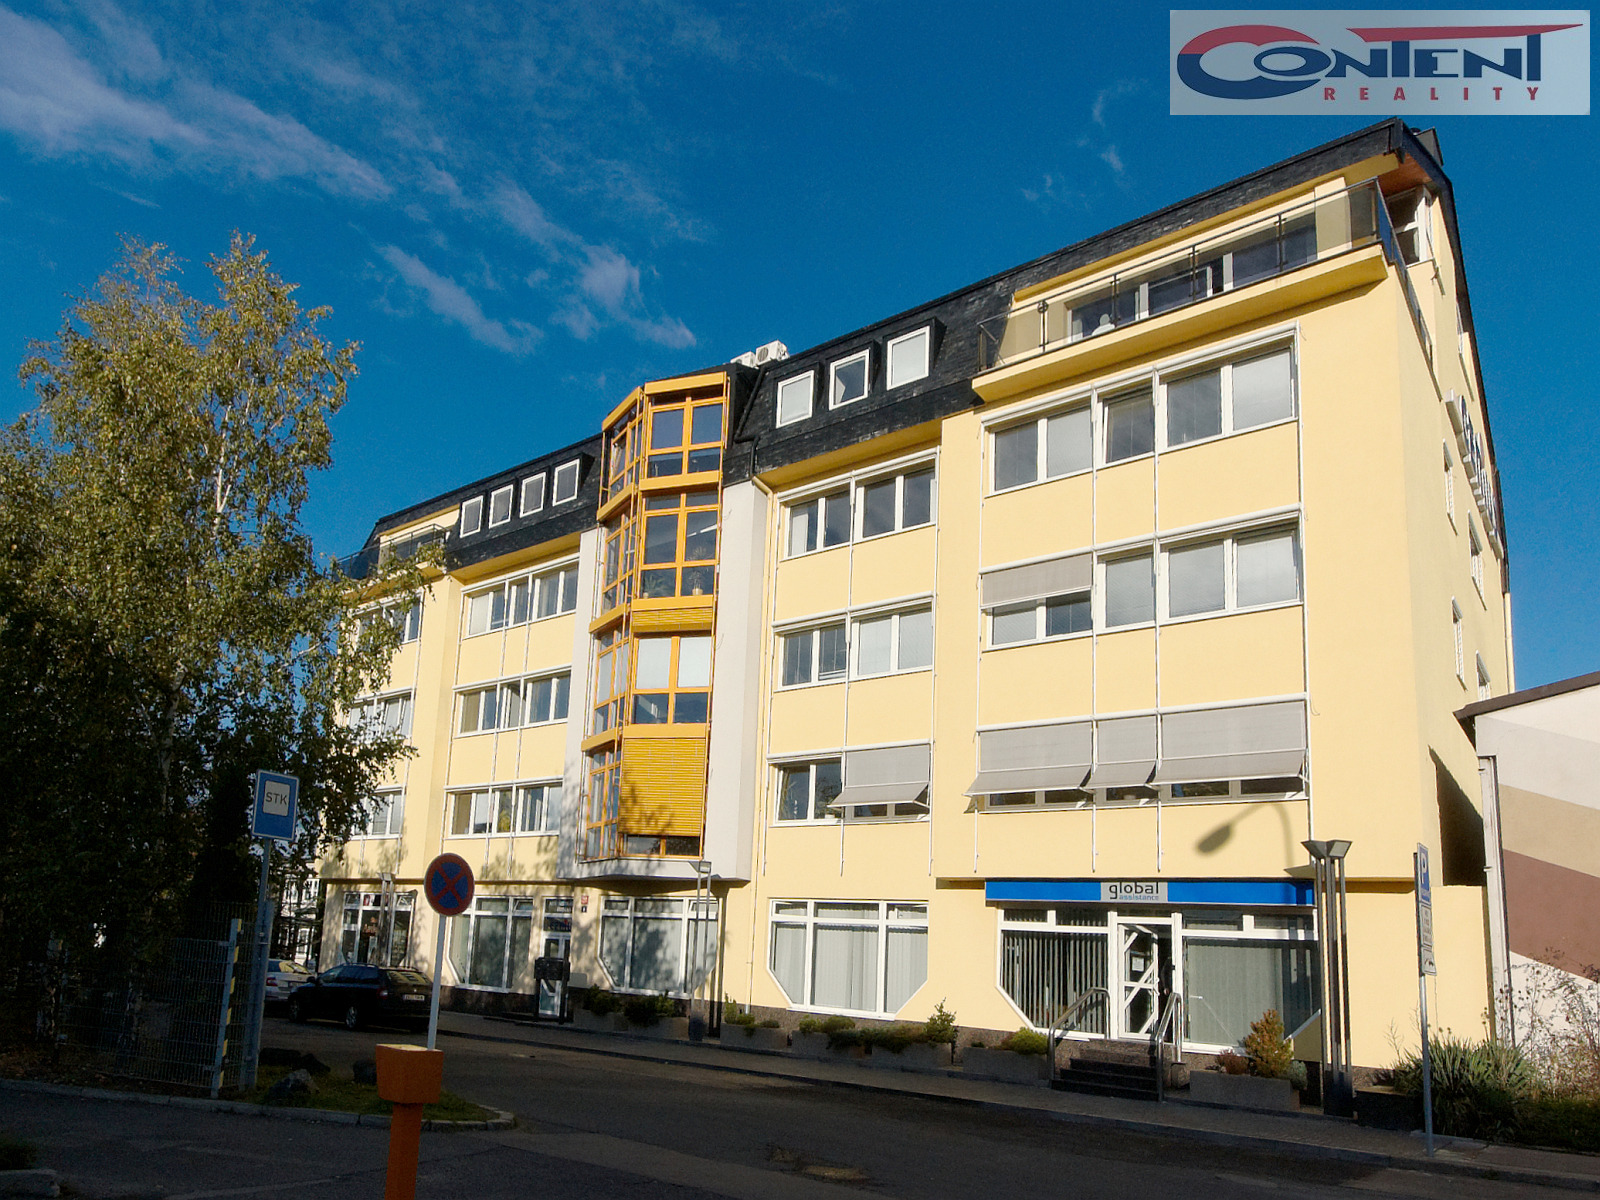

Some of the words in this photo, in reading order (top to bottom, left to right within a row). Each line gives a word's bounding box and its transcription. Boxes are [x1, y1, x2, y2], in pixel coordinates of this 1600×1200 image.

[265, 791, 287, 805] STK
[1420, 853, 1428, 884] P
[1109, 881, 1159, 899] global
